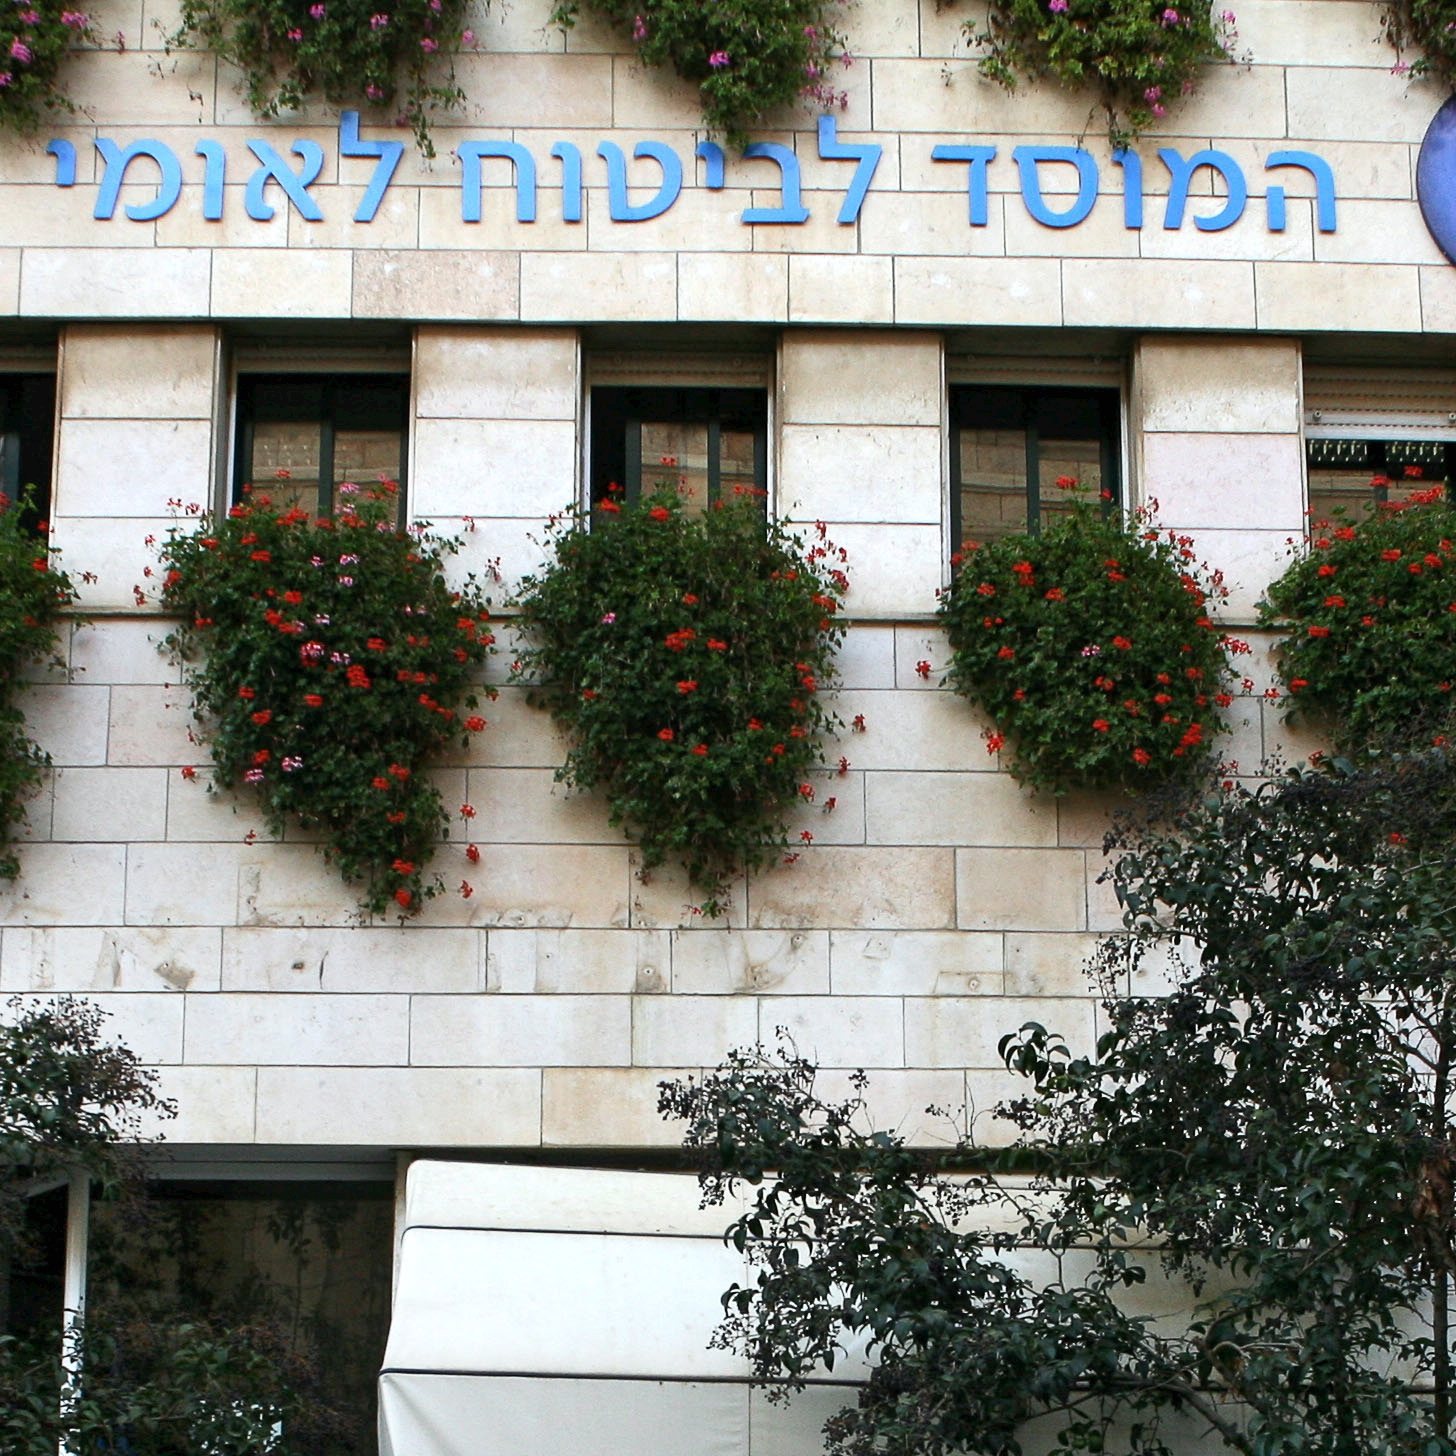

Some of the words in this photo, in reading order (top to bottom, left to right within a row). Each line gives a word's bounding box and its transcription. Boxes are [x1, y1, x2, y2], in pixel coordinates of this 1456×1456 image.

[45, 110, 405, 222] לאומי
[456, 114, 883, 225] לביטוח
[931, 144, 1337, 233] המוסד
